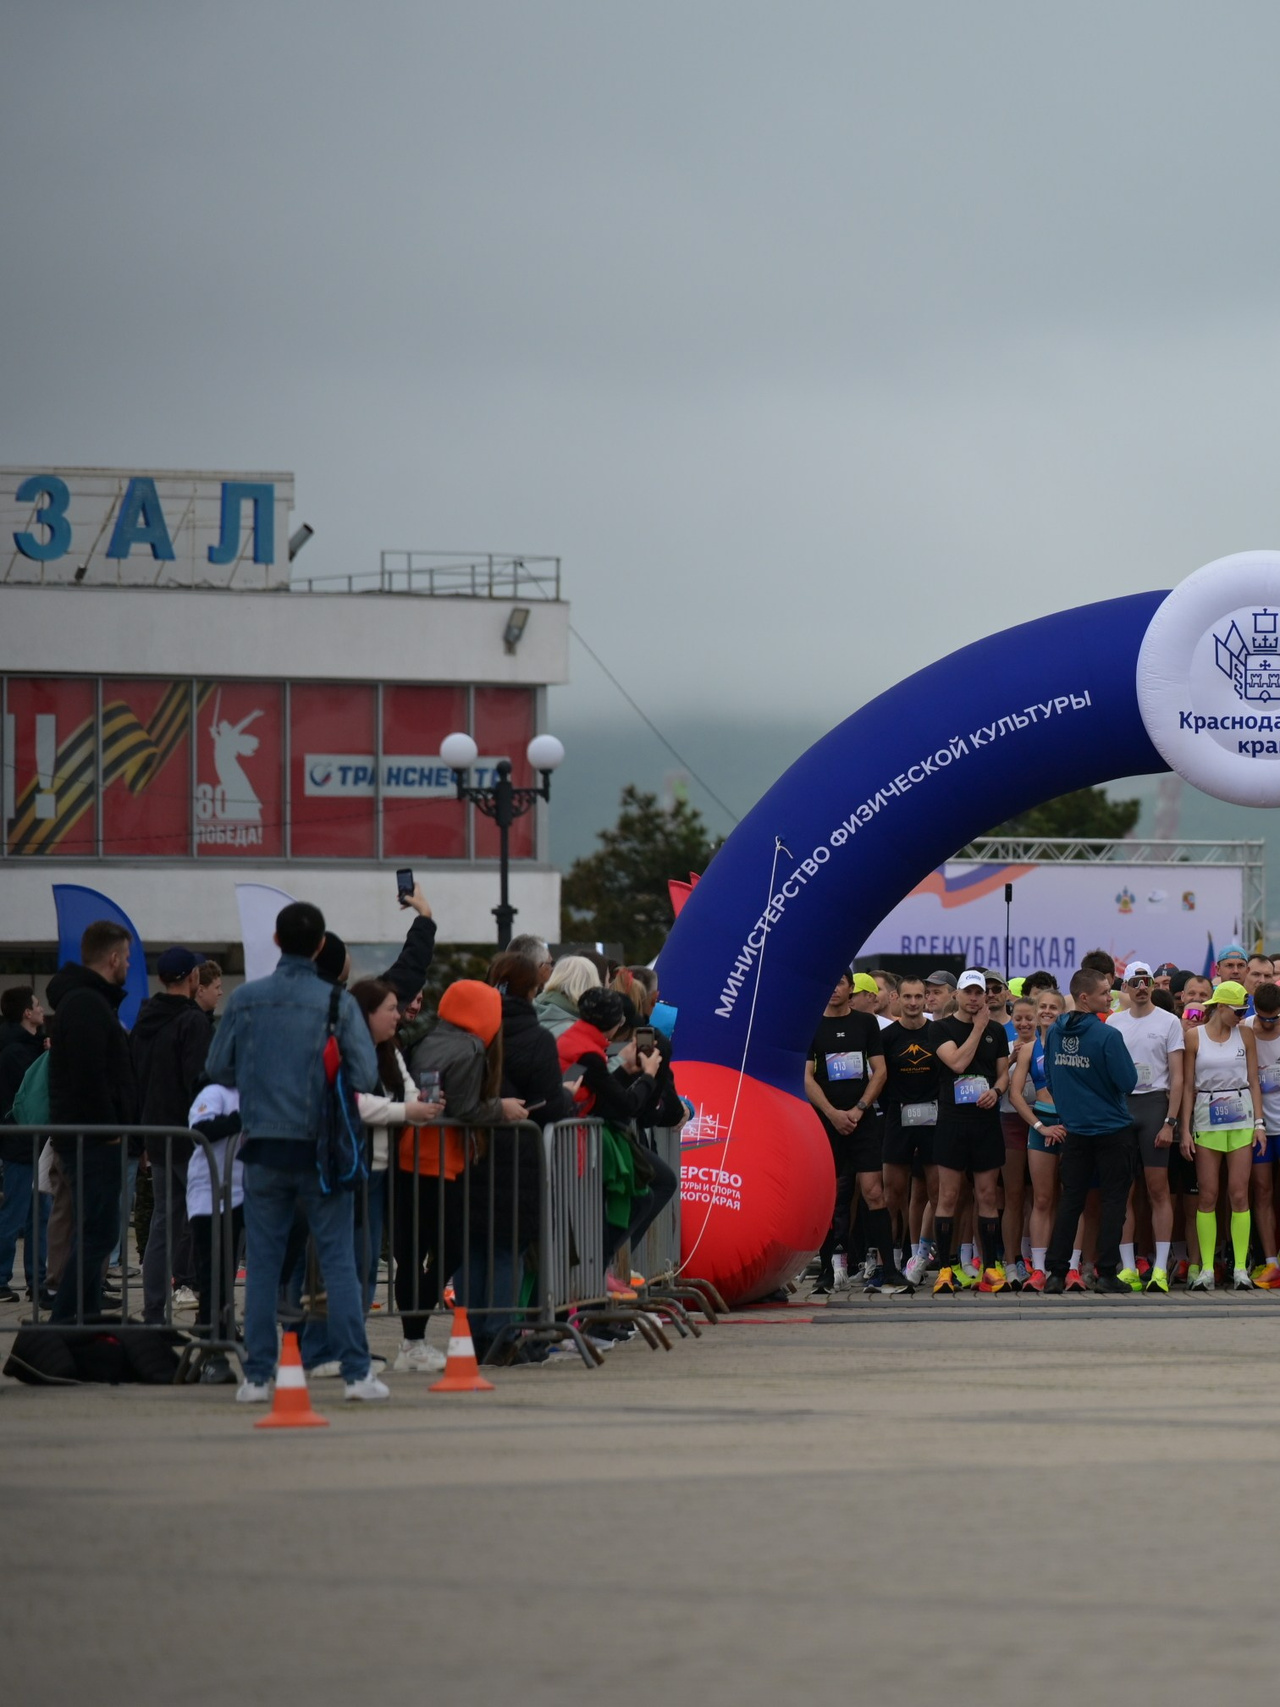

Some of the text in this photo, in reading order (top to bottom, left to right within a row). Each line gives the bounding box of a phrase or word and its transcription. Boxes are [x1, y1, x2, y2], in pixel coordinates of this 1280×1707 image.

[13, 474, 275, 565] ЗАЛ
[715, 690, 1092, 1018] МИНИСТЕРСТВО ФИЗИЧЕСКОЙ КУЛЬТУРЫ
[710, 1184, 741, 1200] СПОРТА
[712, 1195, 741, 1212] КРАЯ
